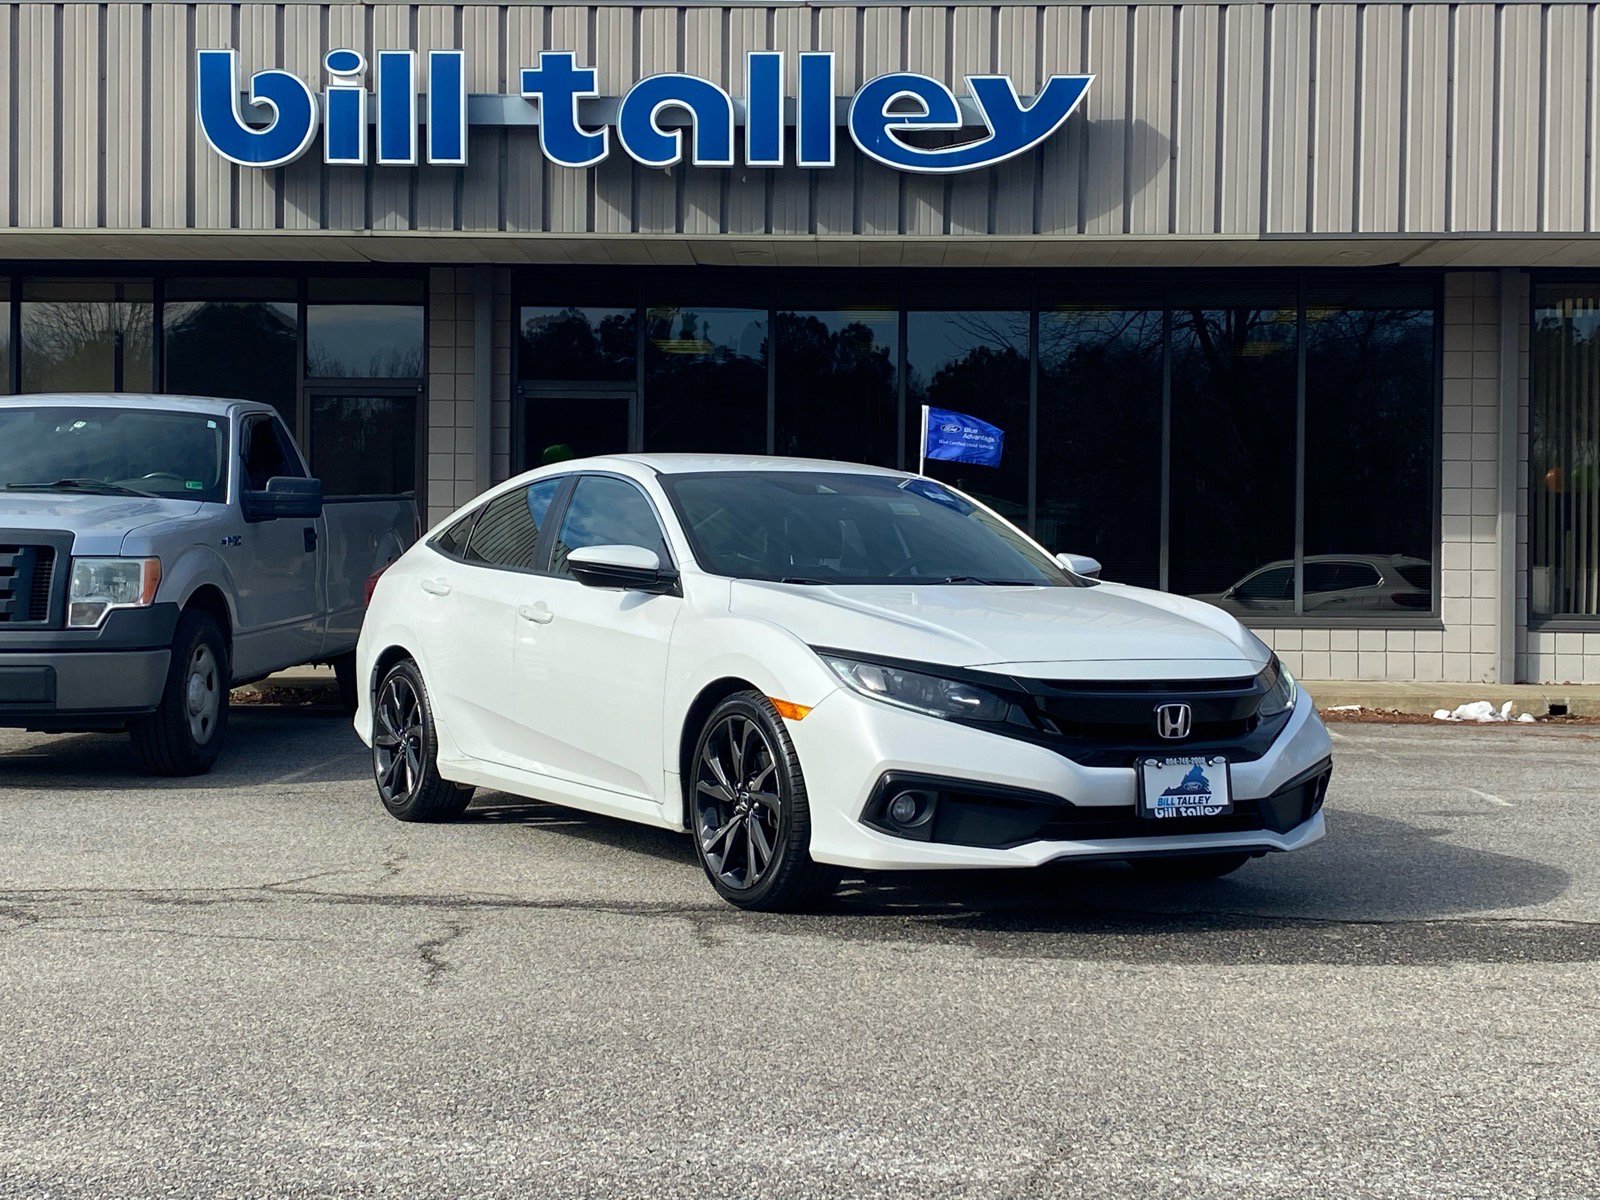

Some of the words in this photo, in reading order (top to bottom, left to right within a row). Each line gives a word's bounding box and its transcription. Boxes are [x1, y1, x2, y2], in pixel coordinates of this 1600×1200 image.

[195, 48, 468, 168] bill
[519, 50, 1096, 174] talley
[962, 433, 996, 443] Advantage
[1157, 797, 1176, 807] BILL
[1177, 796, 1211, 806] TALLEY
[1154, 807, 1177, 818] bill
[1180, 806, 1223, 817] talley
